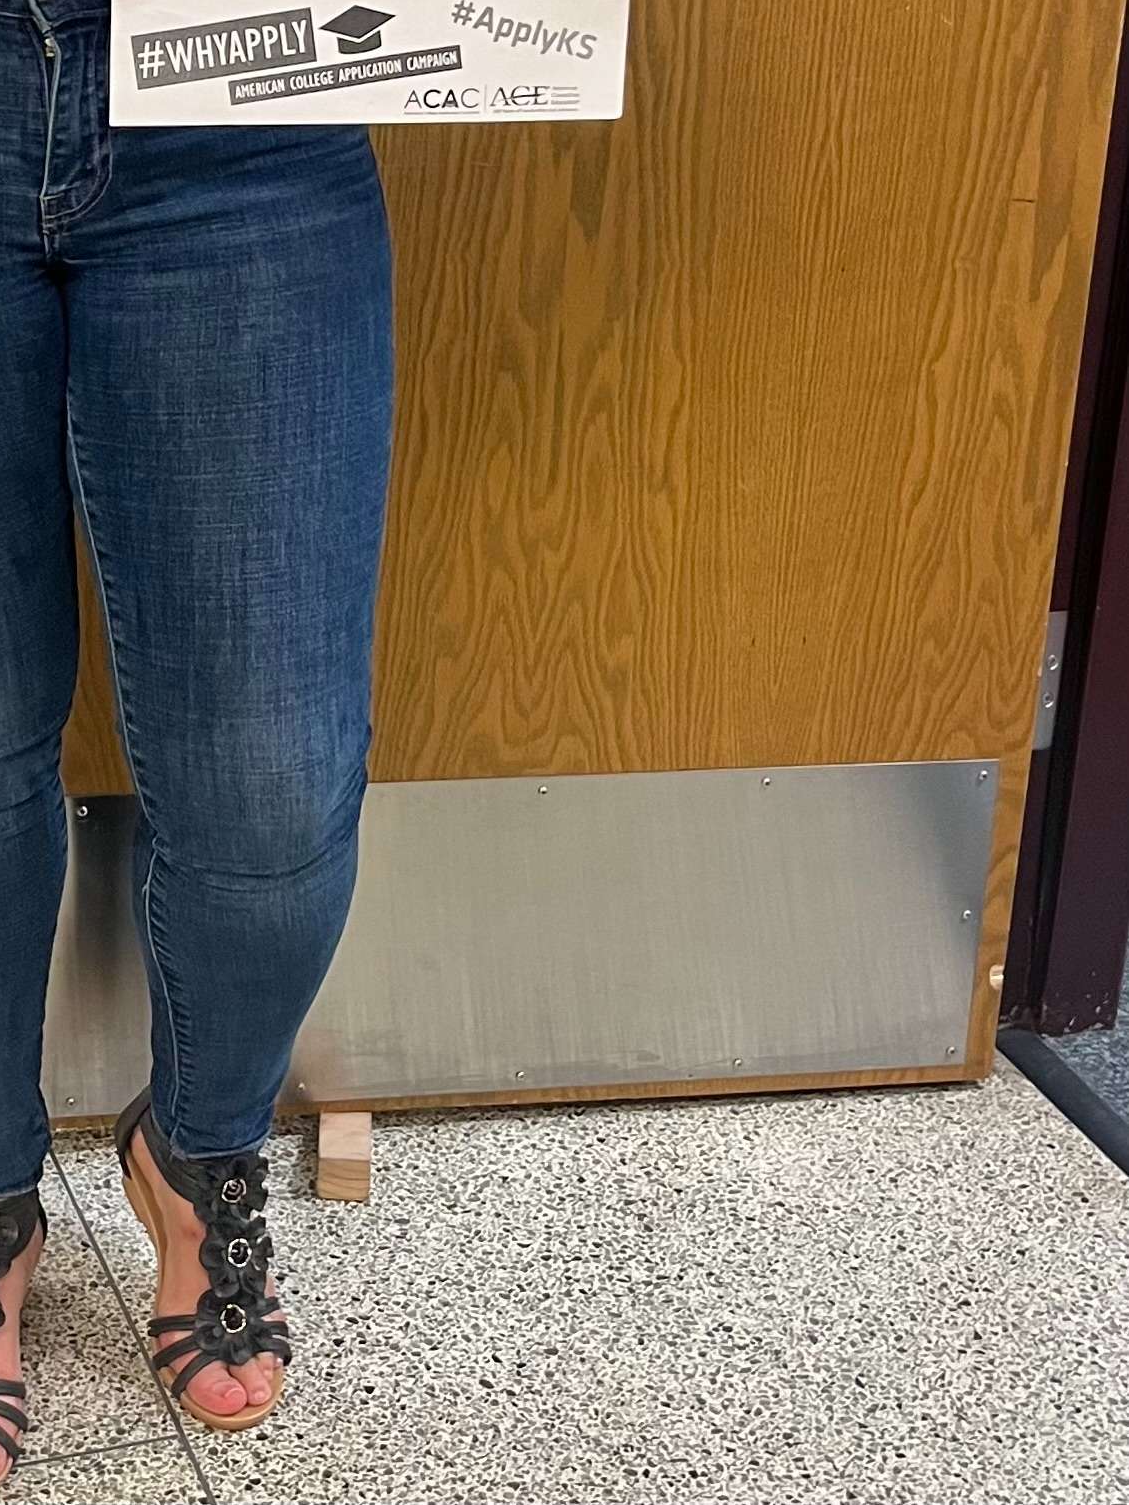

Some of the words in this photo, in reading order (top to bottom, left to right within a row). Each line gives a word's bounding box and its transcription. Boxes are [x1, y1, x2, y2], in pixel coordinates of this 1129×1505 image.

[136, 19, 309, 79] #WHYAPPLY
[234, 80, 285, 99] AMERICAN
[289, 71, 334, 91] COLLEGE
[337, 60, 402, 82] APPLICATION
[406, 50, 459, 72] CAMPAIGN
[404, 88, 480, 108] ACAC
[490, 85, 551, 107] ACE
